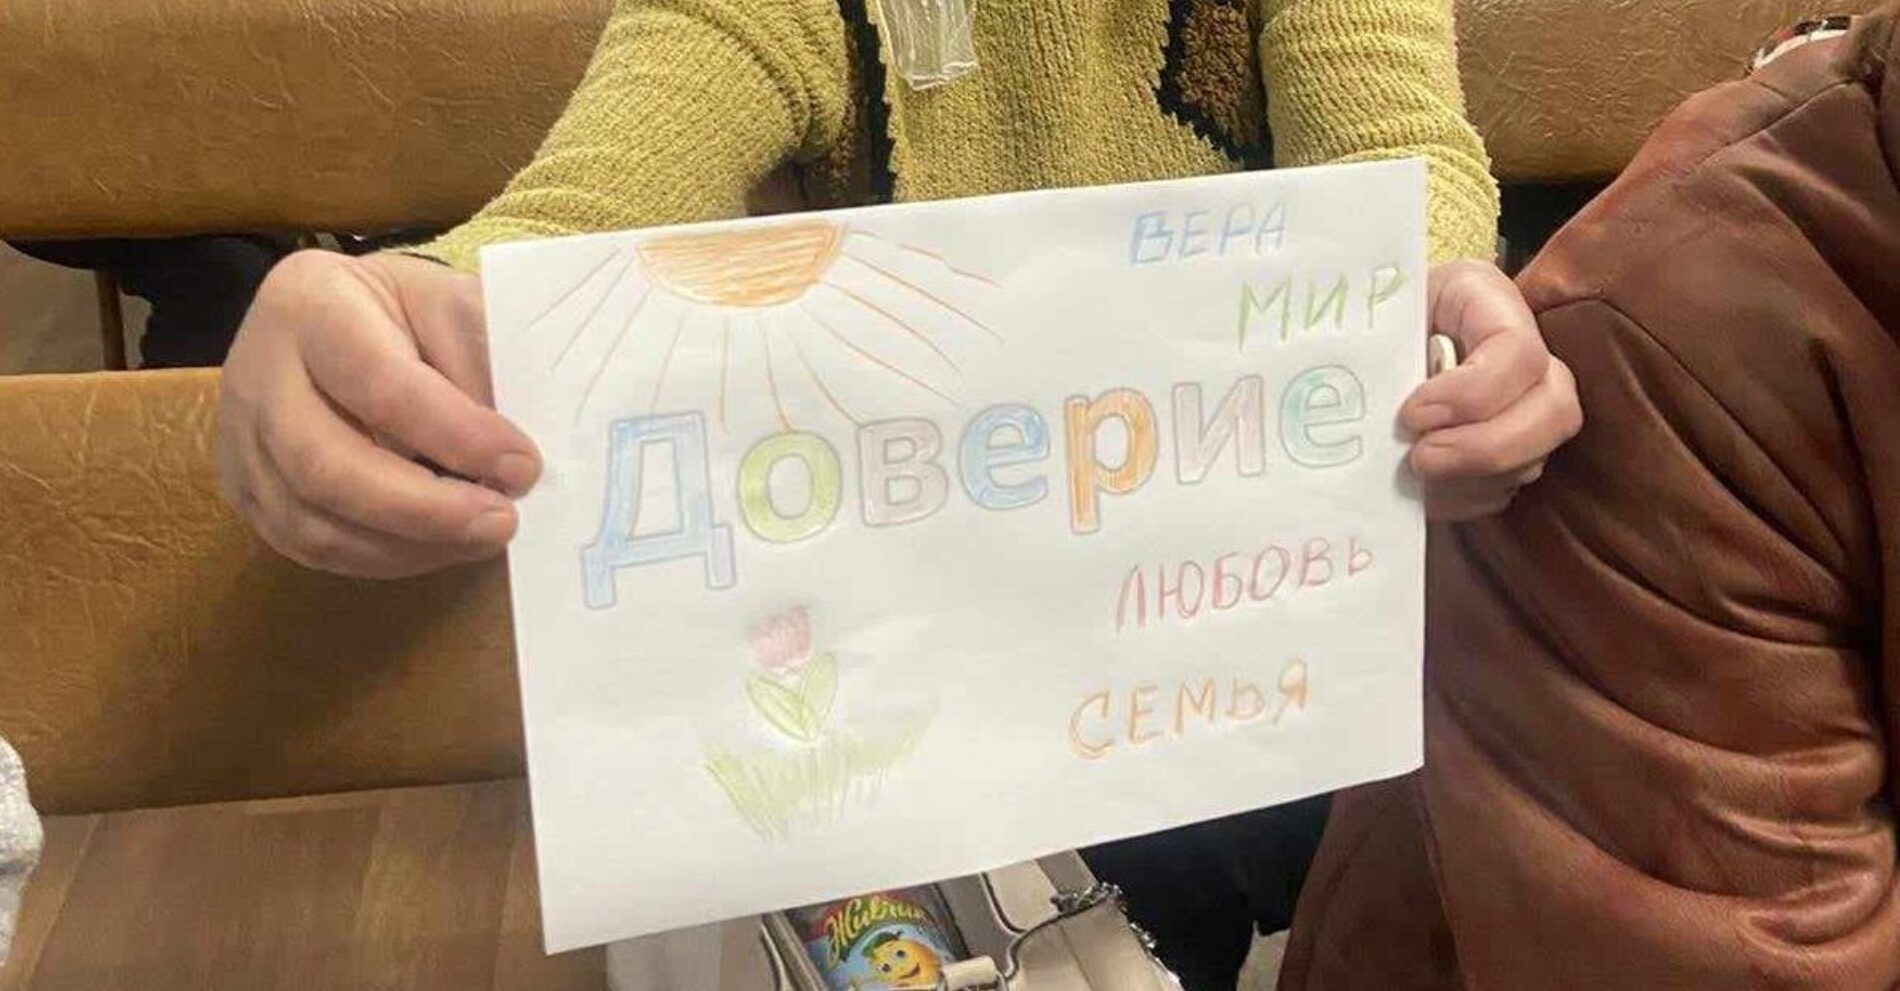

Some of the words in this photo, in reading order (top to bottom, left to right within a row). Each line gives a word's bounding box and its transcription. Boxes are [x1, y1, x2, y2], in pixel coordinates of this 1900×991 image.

[1130, 198, 1287, 264] ВЕРА
[1236, 266, 1405, 353] МИР
[580, 364, 1367, 610] Доверие
[1115, 535, 1374, 633] ЛЮБОВЬ
[1069, 656, 1310, 759] СЕМЬЯ
